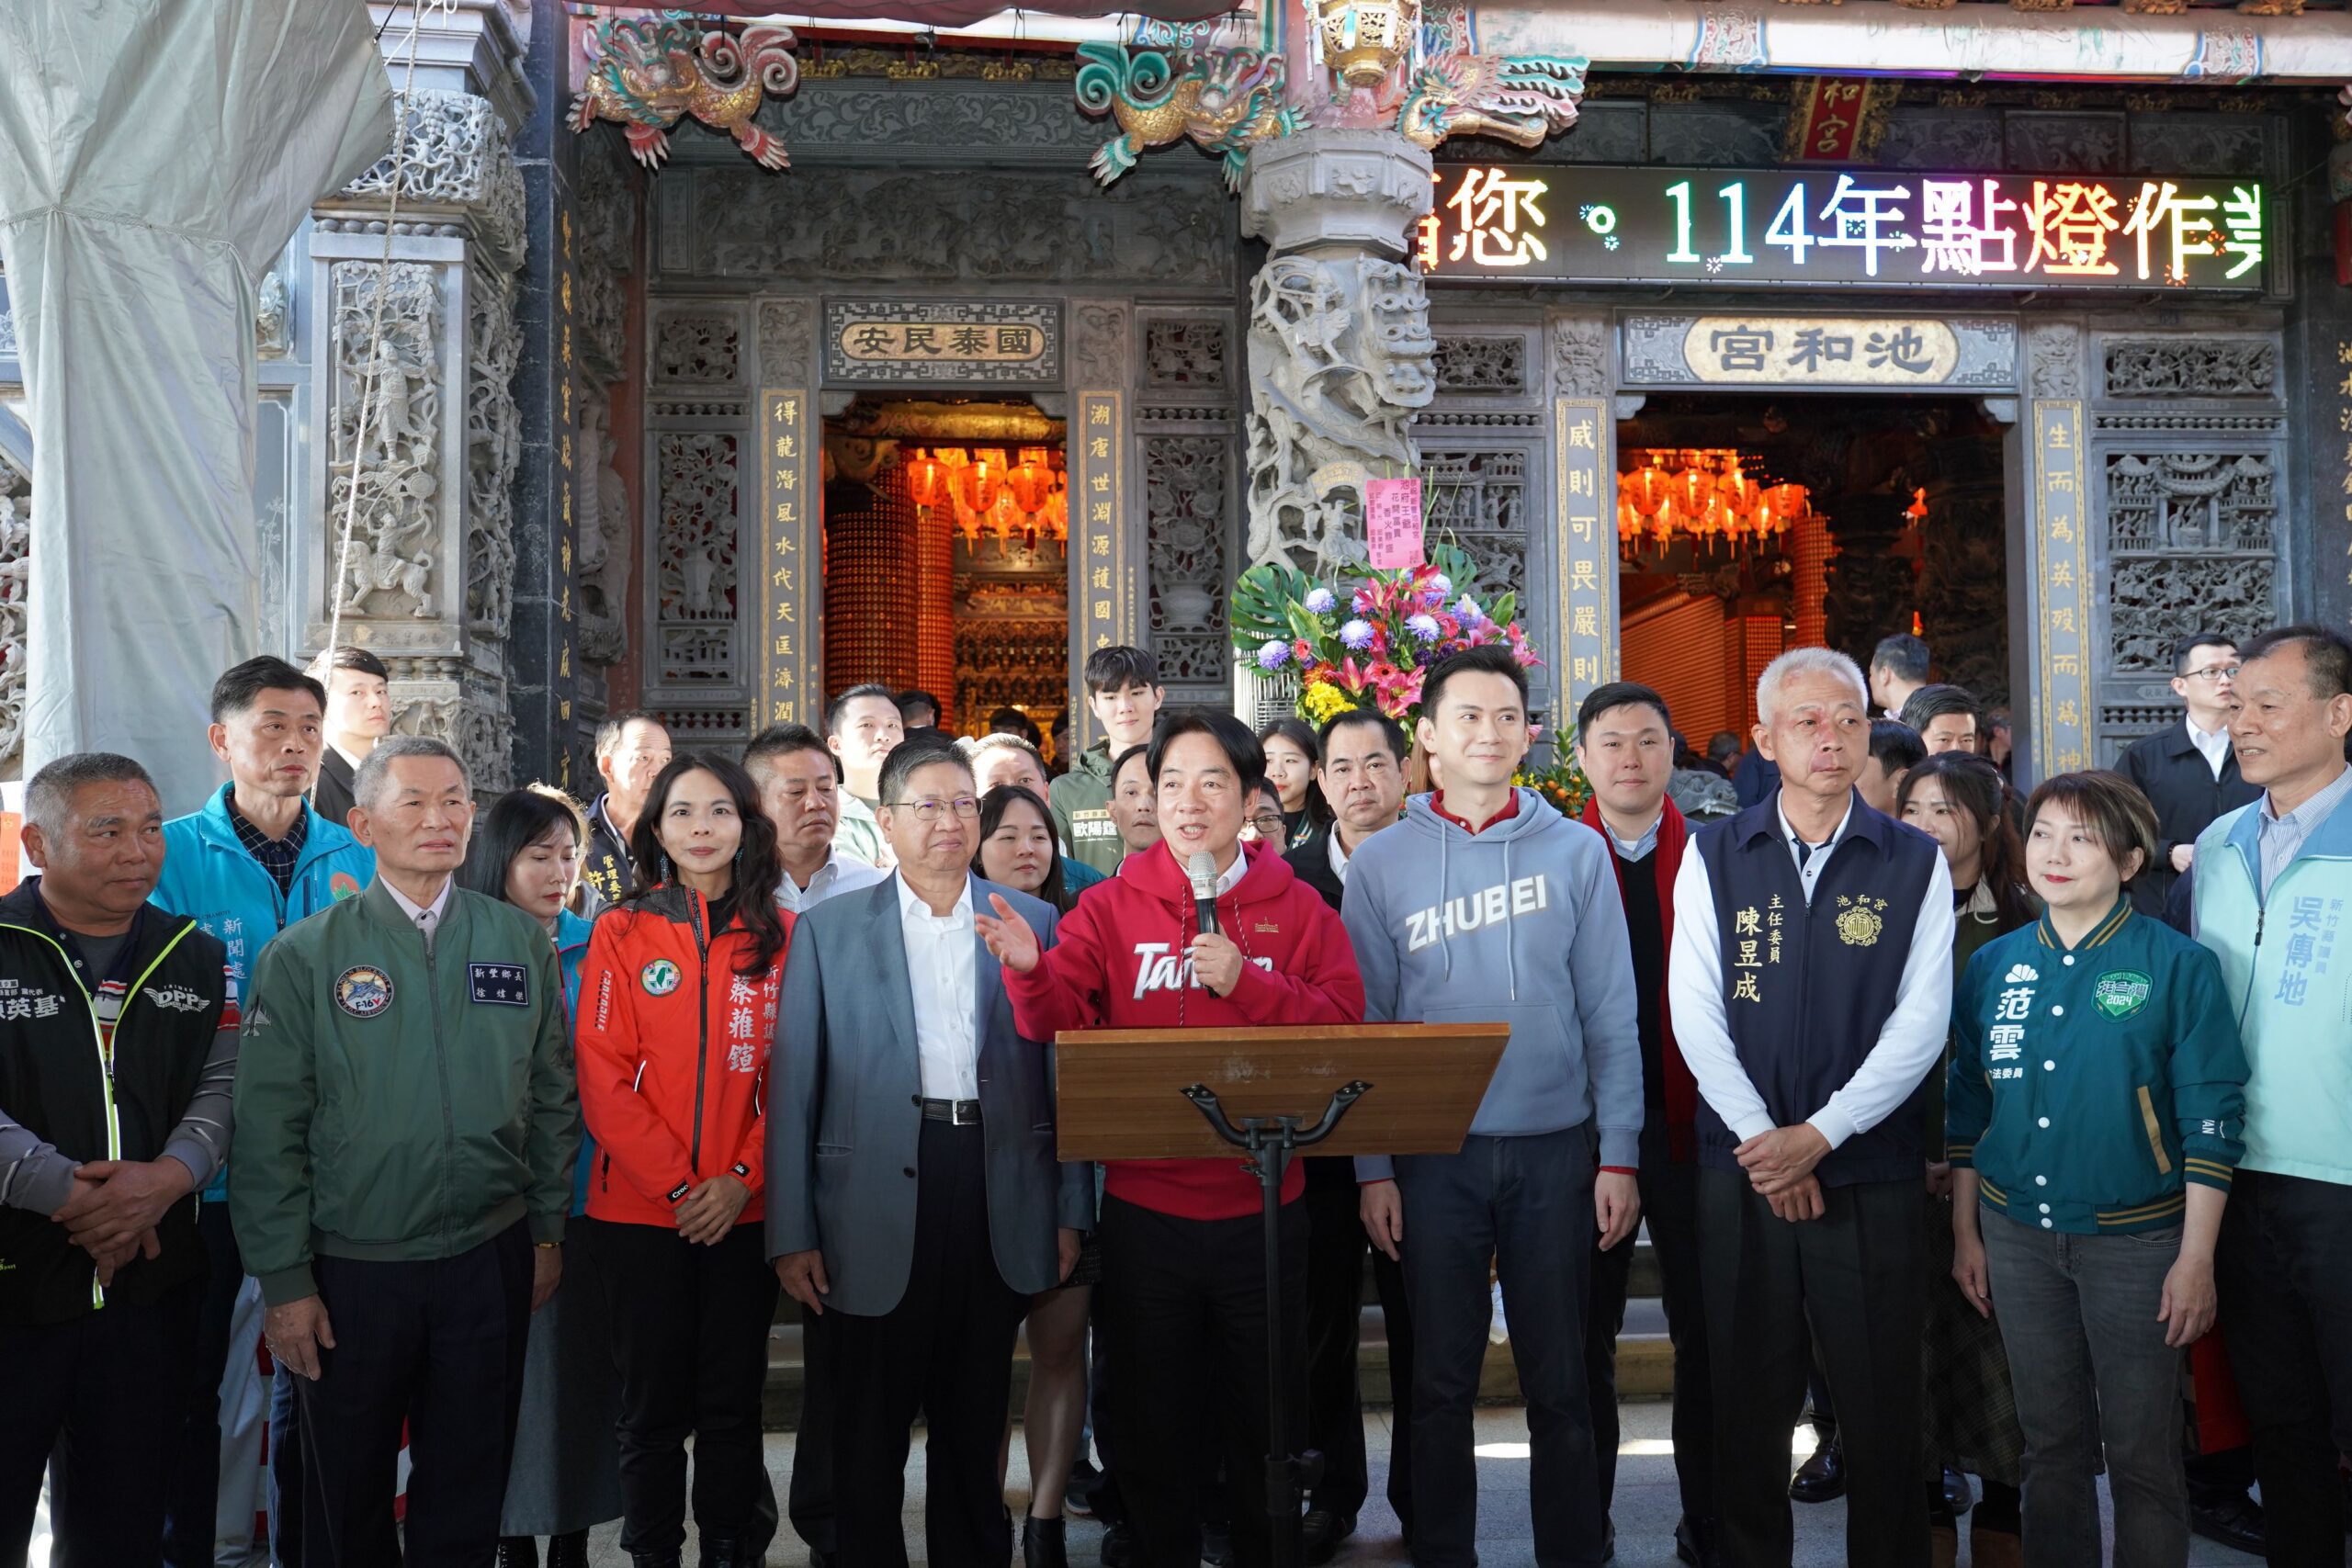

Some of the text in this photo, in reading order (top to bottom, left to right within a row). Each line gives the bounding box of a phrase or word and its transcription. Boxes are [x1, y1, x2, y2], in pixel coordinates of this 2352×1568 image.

[1405, 874, 1547, 953] ZHUBEI
[1836, 894, 1889, 912] 池和宮
[1767, 894, 1785, 964] 主任委員
[1732, 906, 1763, 1003] 陳昱成
[0, 994, 60, 1021] 英基
[158, 989, 198, 1006] DPP
[2106, 995, 2132, 1006] 2024
[1989, 987, 2036, 1061] 范雲
